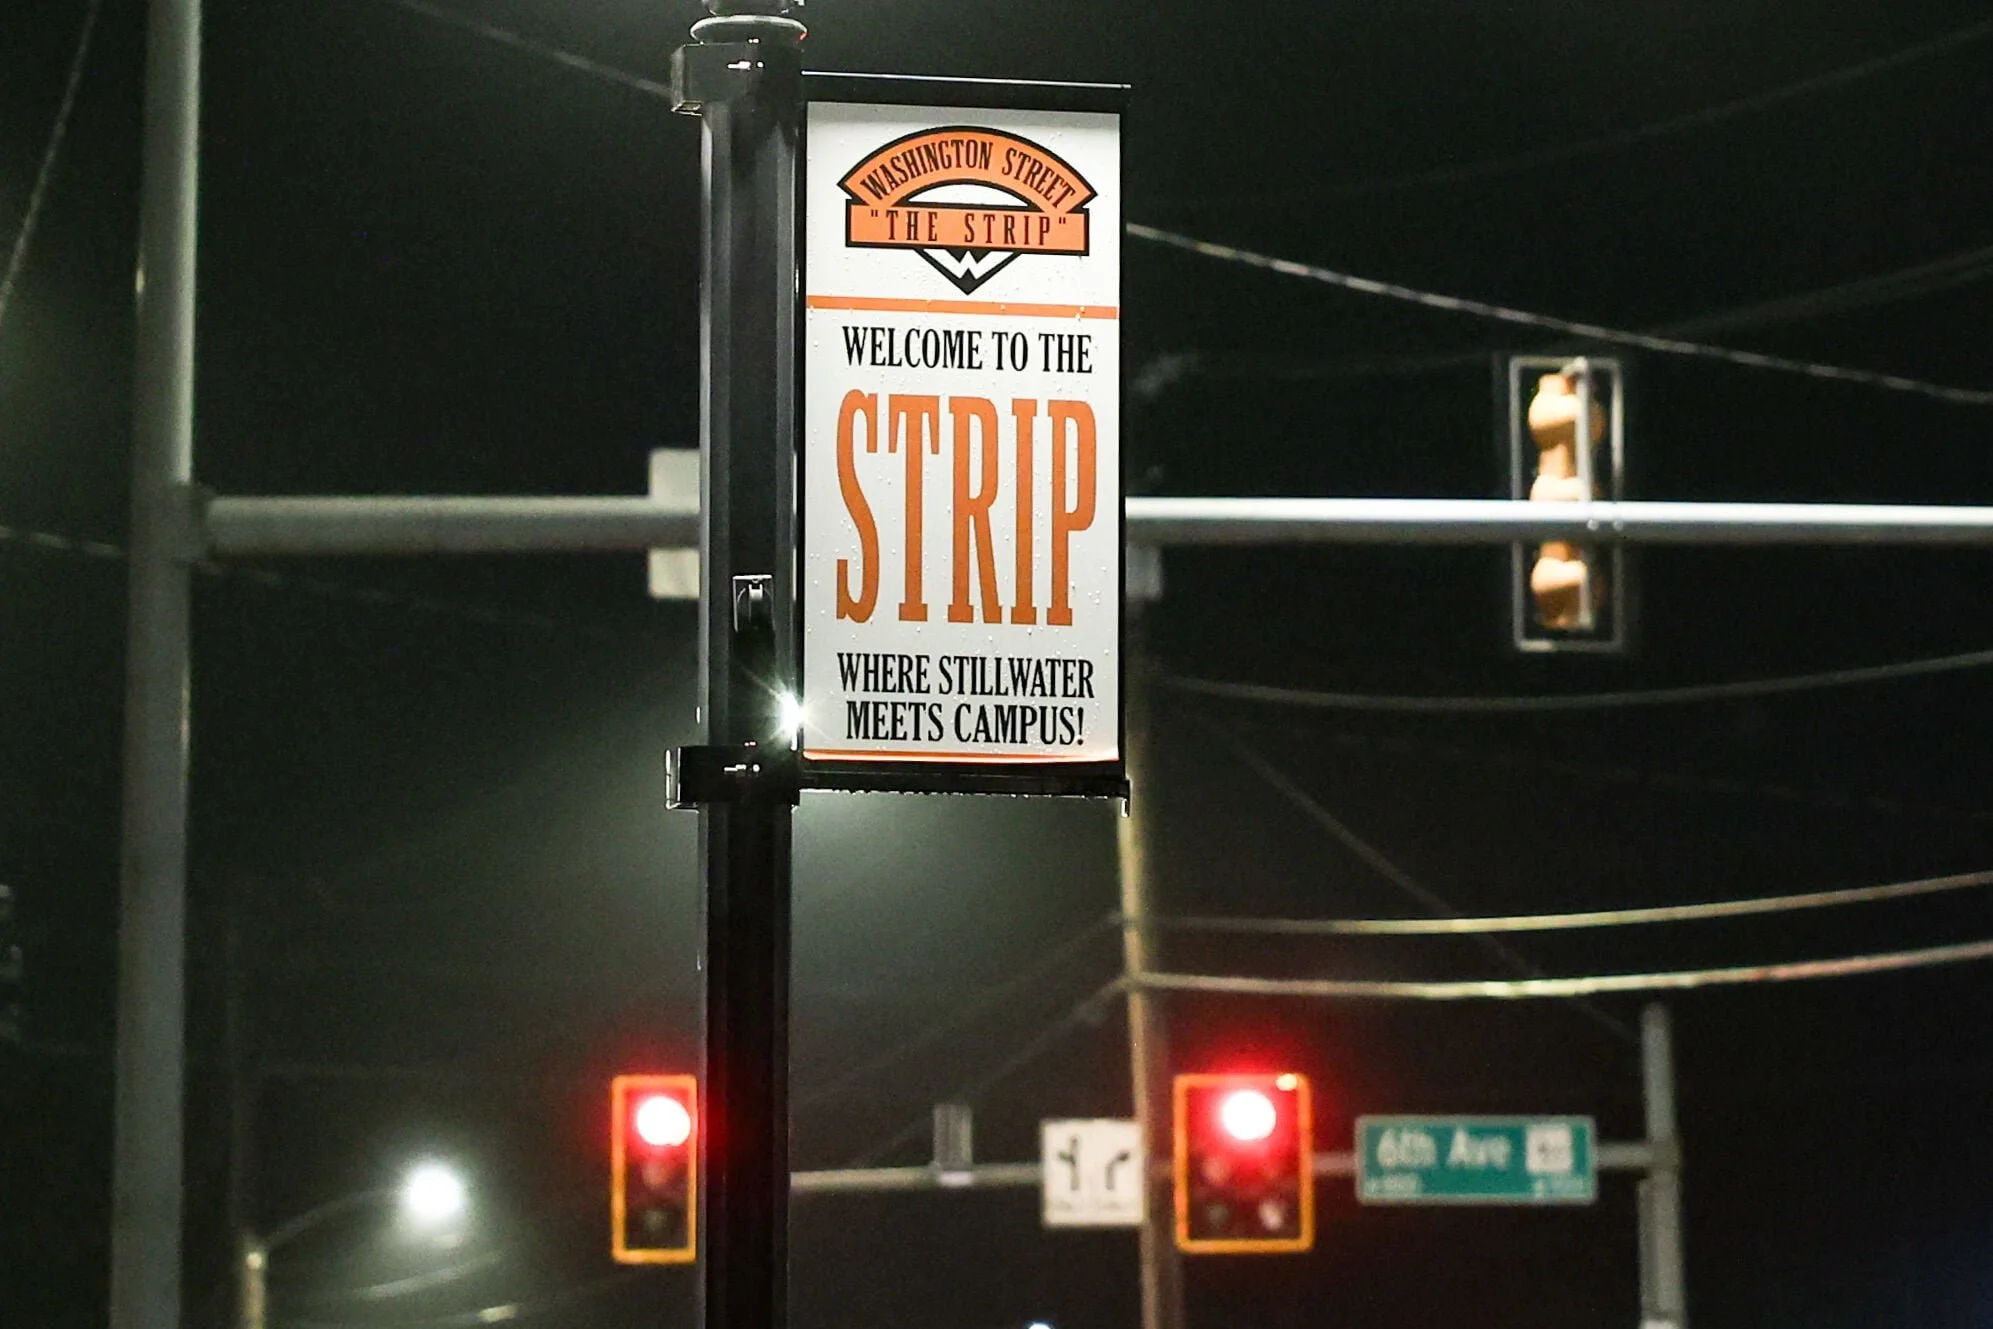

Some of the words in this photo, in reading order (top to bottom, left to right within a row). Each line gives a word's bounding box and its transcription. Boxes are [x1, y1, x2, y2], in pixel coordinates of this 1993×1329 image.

[860, 139, 993, 201] WASHINGTON
[1002, 148, 1076, 208] STREET
[870, 209, 938, 242] "THE
[964, 213, 1067, 246] STRIP"
[842, 325, 983, 370] WELCOME
[992, 331, 1028, 372] TO
[1038, 332, 1093, 374] THE
[836, 388, 1097, 627] STRIP
[836, 652, 931, 695] WHERE
[938, 655, 1095, 699] STILLWATER
[846, 700, 944, 743] MEETS
[953, 703, 1085, 746] CAMPUS!
[1446, 1127, 1512, 1169] Ave
